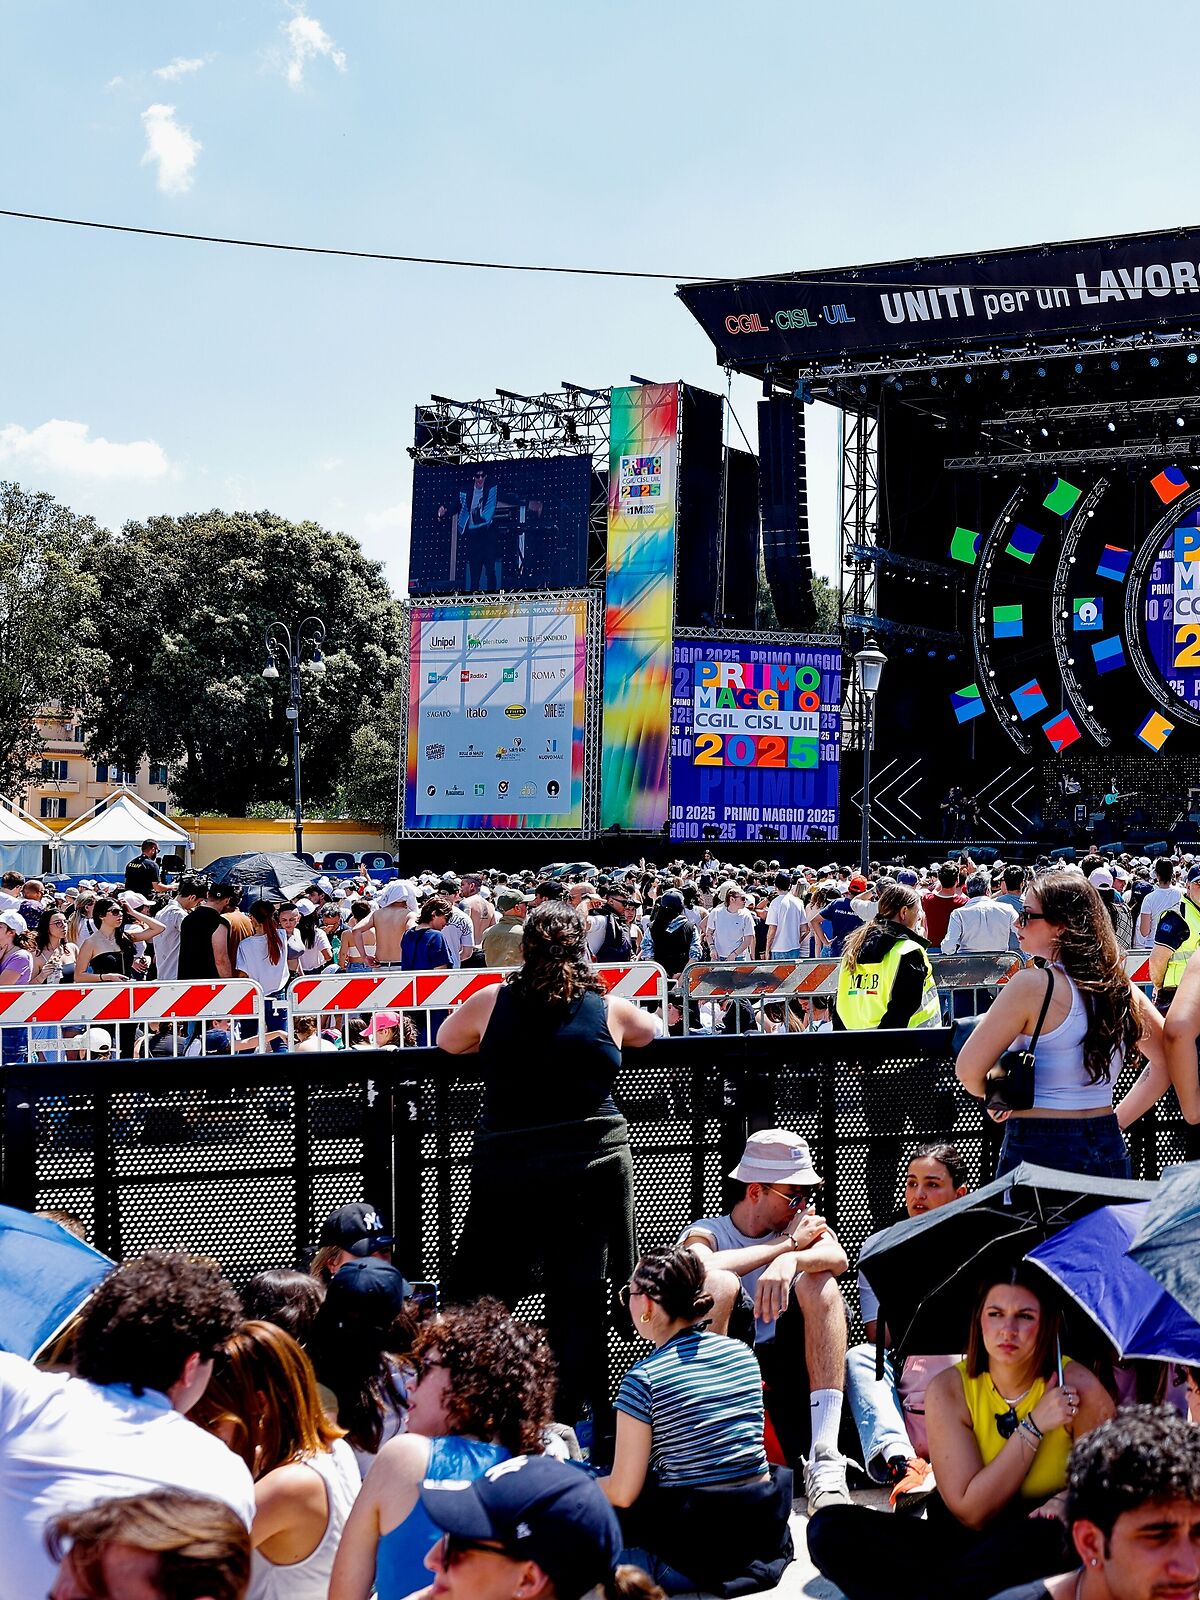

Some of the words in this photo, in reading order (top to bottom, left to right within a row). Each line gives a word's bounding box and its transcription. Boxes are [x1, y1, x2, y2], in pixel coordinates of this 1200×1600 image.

[880, 287, 975, 324] UNITI
[983, 290, 1030, 320] per
[1035, 287, 1071, 310] un
[725, 314, 769, 335] CGIL
[775, 308, 817, 330] CISL
[824, 304, 856, 325] UIL
[622, 484, 660, 497] 2025
[431, 636, 455, 649] Unipol
[532, 671, 555, 679] ROMA
[695, 661, 820, 692] PRIMO
[694, 686, 820, 712] MAGGIO
[467, 707, 488, 718] italo
[695, 713, 738, 728] CGIL
[745, 715, 783, 730] CISL
[790, 716, 818, 731] UIL
[694, 733, 819, 768] 2025
[686, 806, 716, 820] 2025
[724, 807, 759, 821] PRIMO
[763, 808, 804, 822] MAGGIO
[807, 809, 835, 823] 2025
